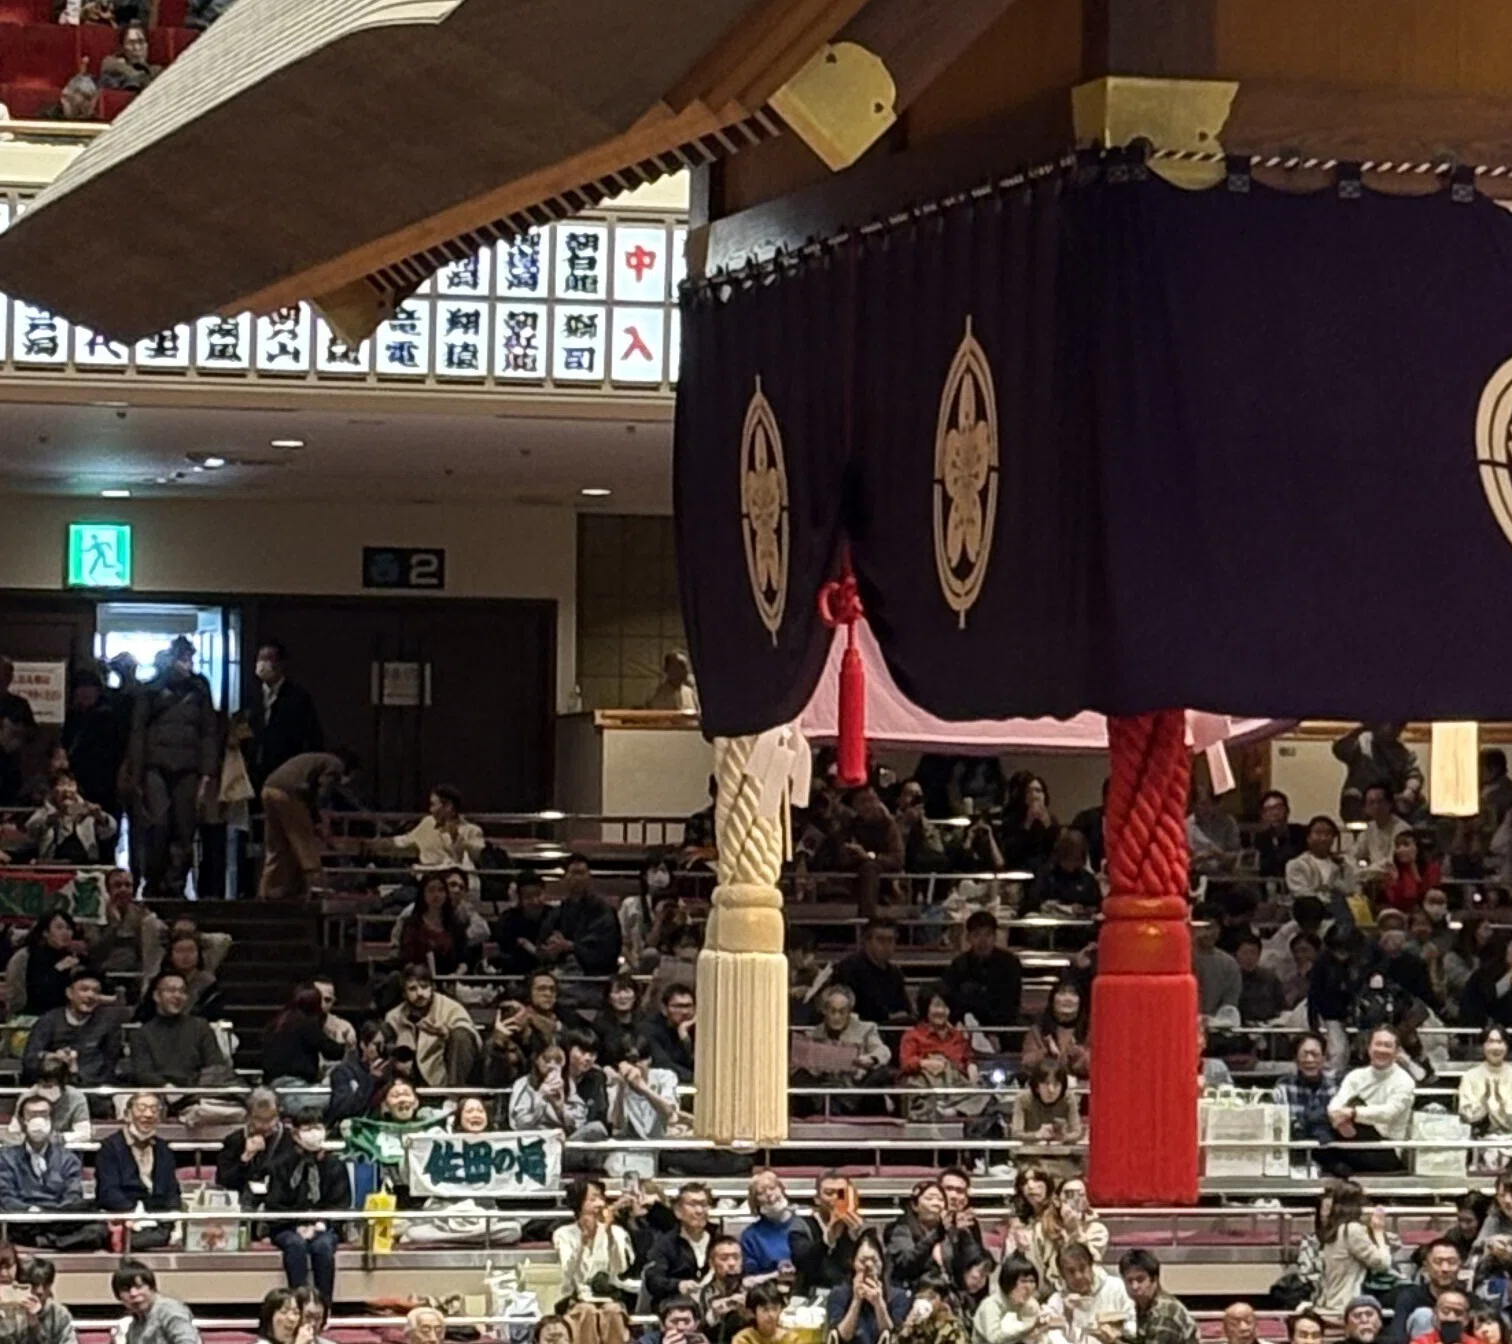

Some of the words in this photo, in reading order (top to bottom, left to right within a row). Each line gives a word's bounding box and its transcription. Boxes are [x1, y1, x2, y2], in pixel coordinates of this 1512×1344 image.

[410, 552, 439, 586] 2
[424, 1135, 549, 1187] 佐田の海
